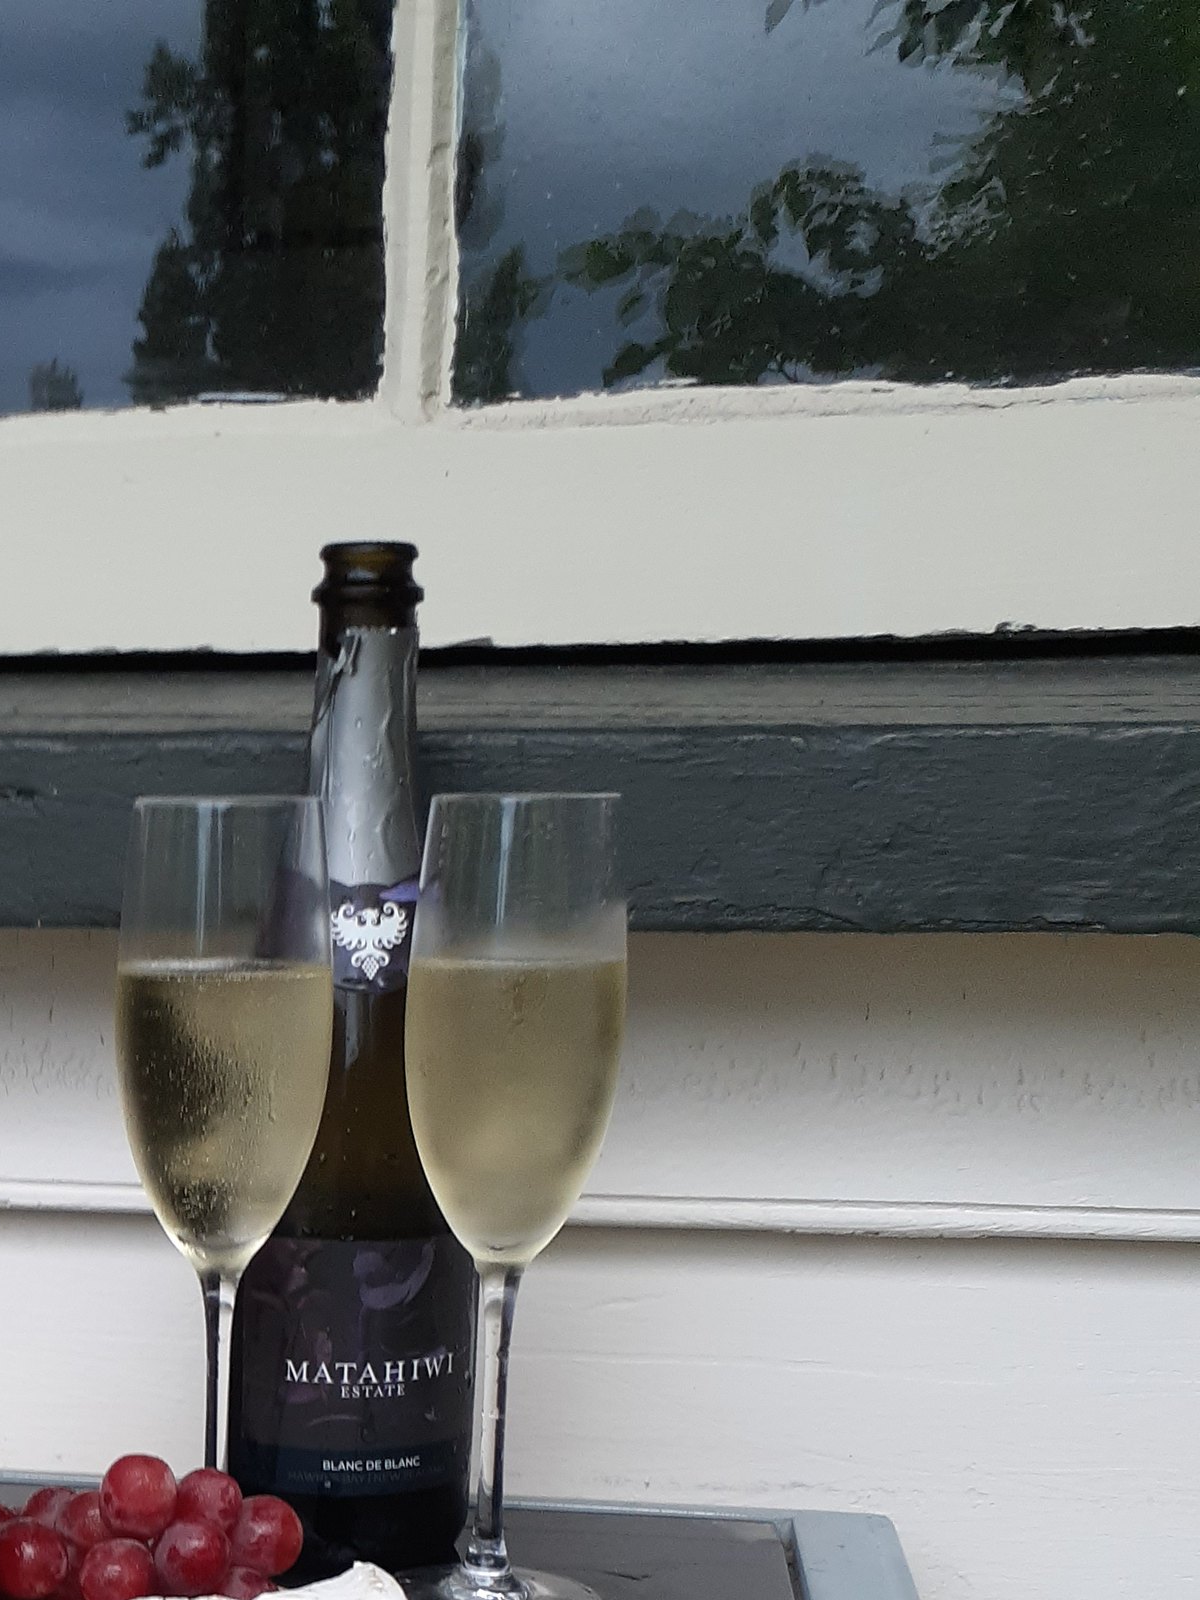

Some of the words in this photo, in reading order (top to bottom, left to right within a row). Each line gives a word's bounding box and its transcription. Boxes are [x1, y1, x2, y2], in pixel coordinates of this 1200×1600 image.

[285, 1353, 453, 1384] MATAHIWI
[340, 1383, 406, 1399] ESTATE
[322, 1459, 363, 1472] BLANC
[365, 1458, 382, 1471] DE
[384, 1455, 421, 1470] BLANC
